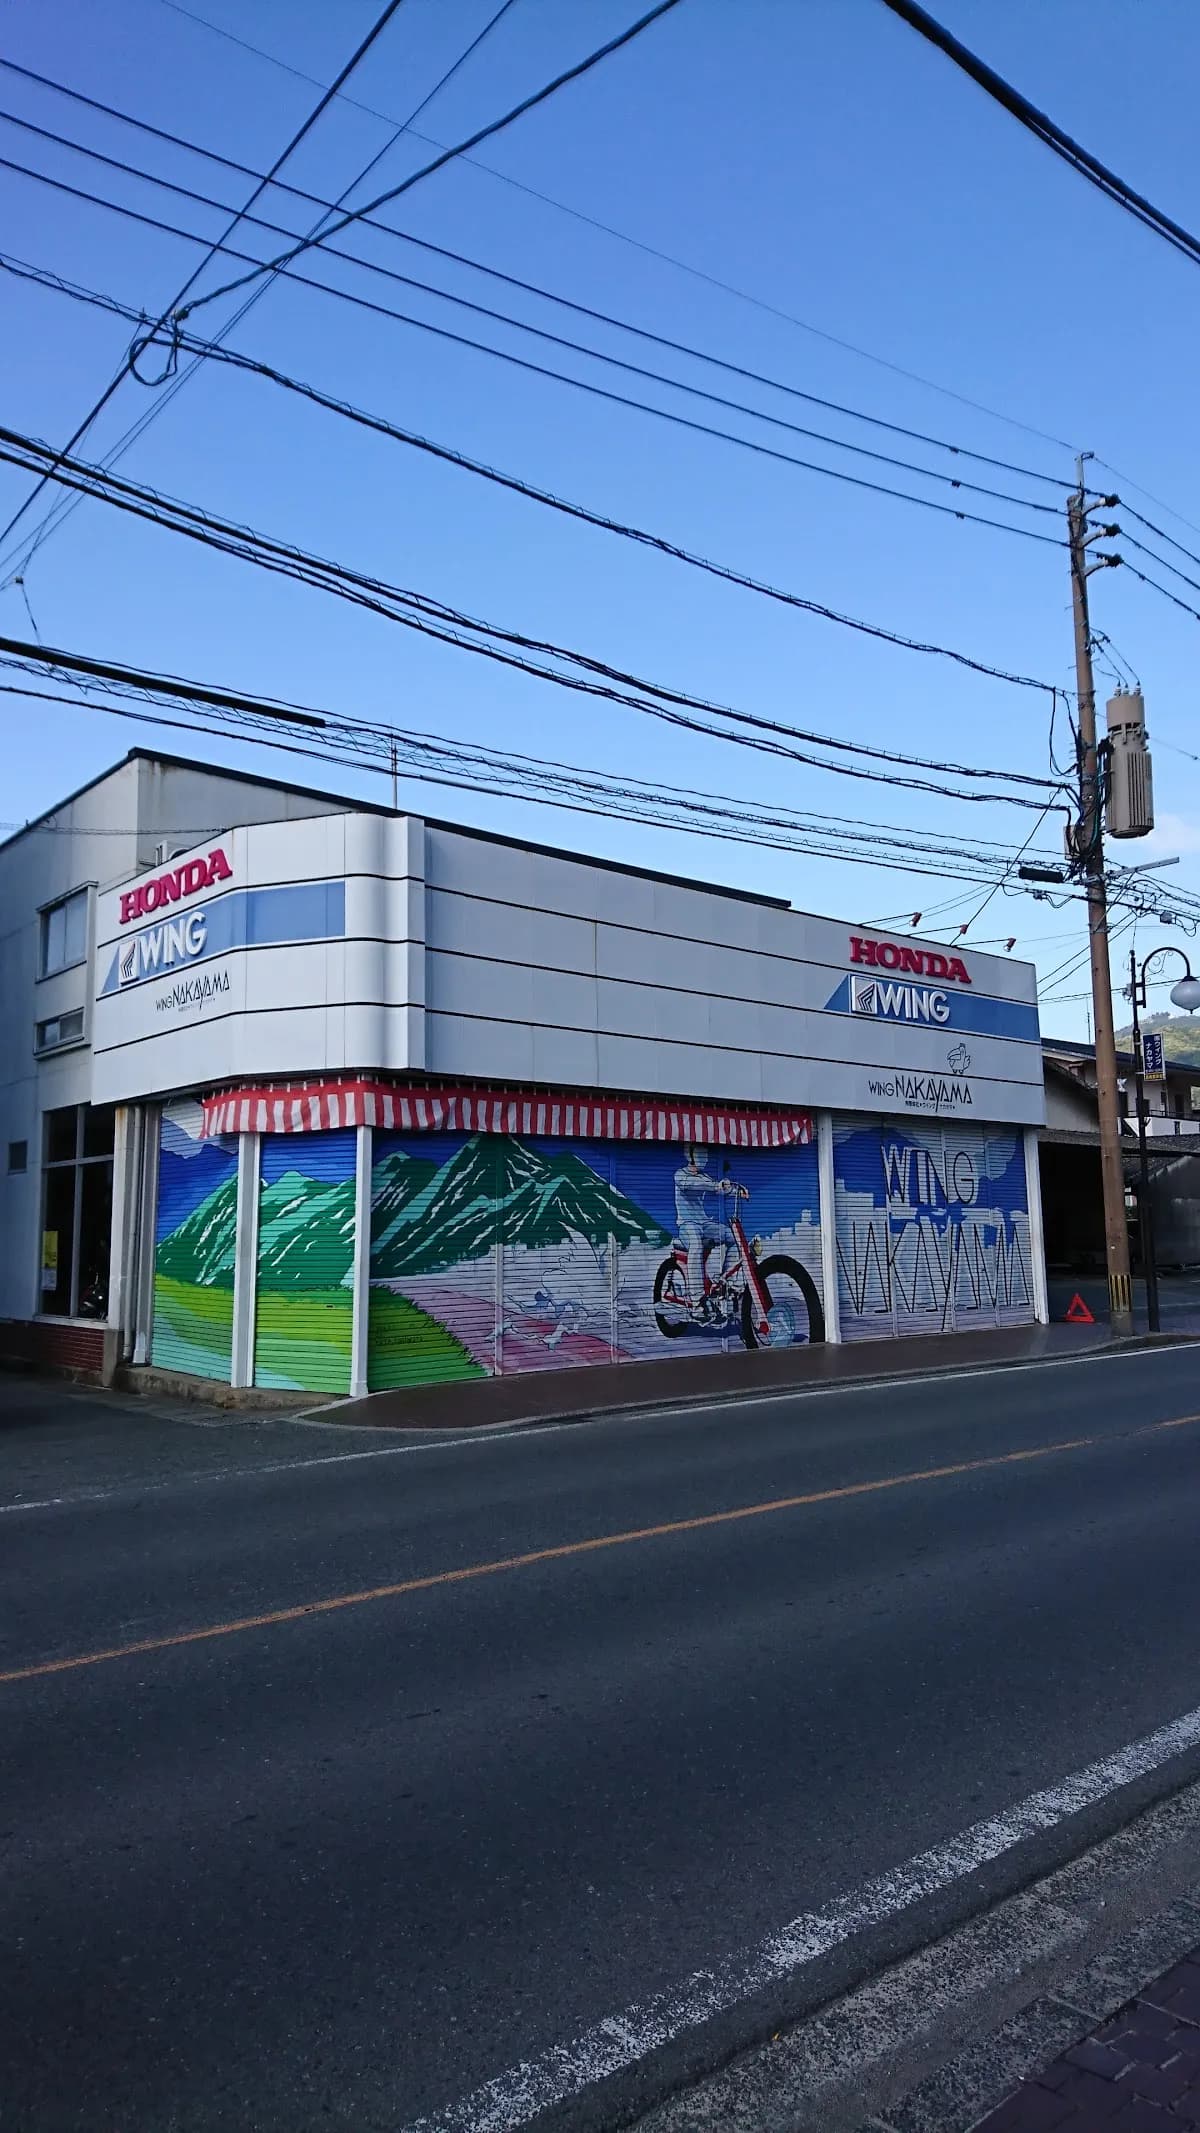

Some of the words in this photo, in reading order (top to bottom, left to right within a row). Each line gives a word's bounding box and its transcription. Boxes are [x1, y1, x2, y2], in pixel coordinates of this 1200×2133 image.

[119, 848, 233, 924] HONDA
[137, 911, 208, 974] WING
[848, 936, 972, 984] HONDA
[155, 995, 173, 1011] WING
[172, 970, 230, 1010] NAKAYAMA
[876, 981, 950, 1023] WING
[868, 1080, 895, 1097] WING
[895, 1074, 973, 1112] NAKAYAMA
[880, 1144, 976, 1205] WING
